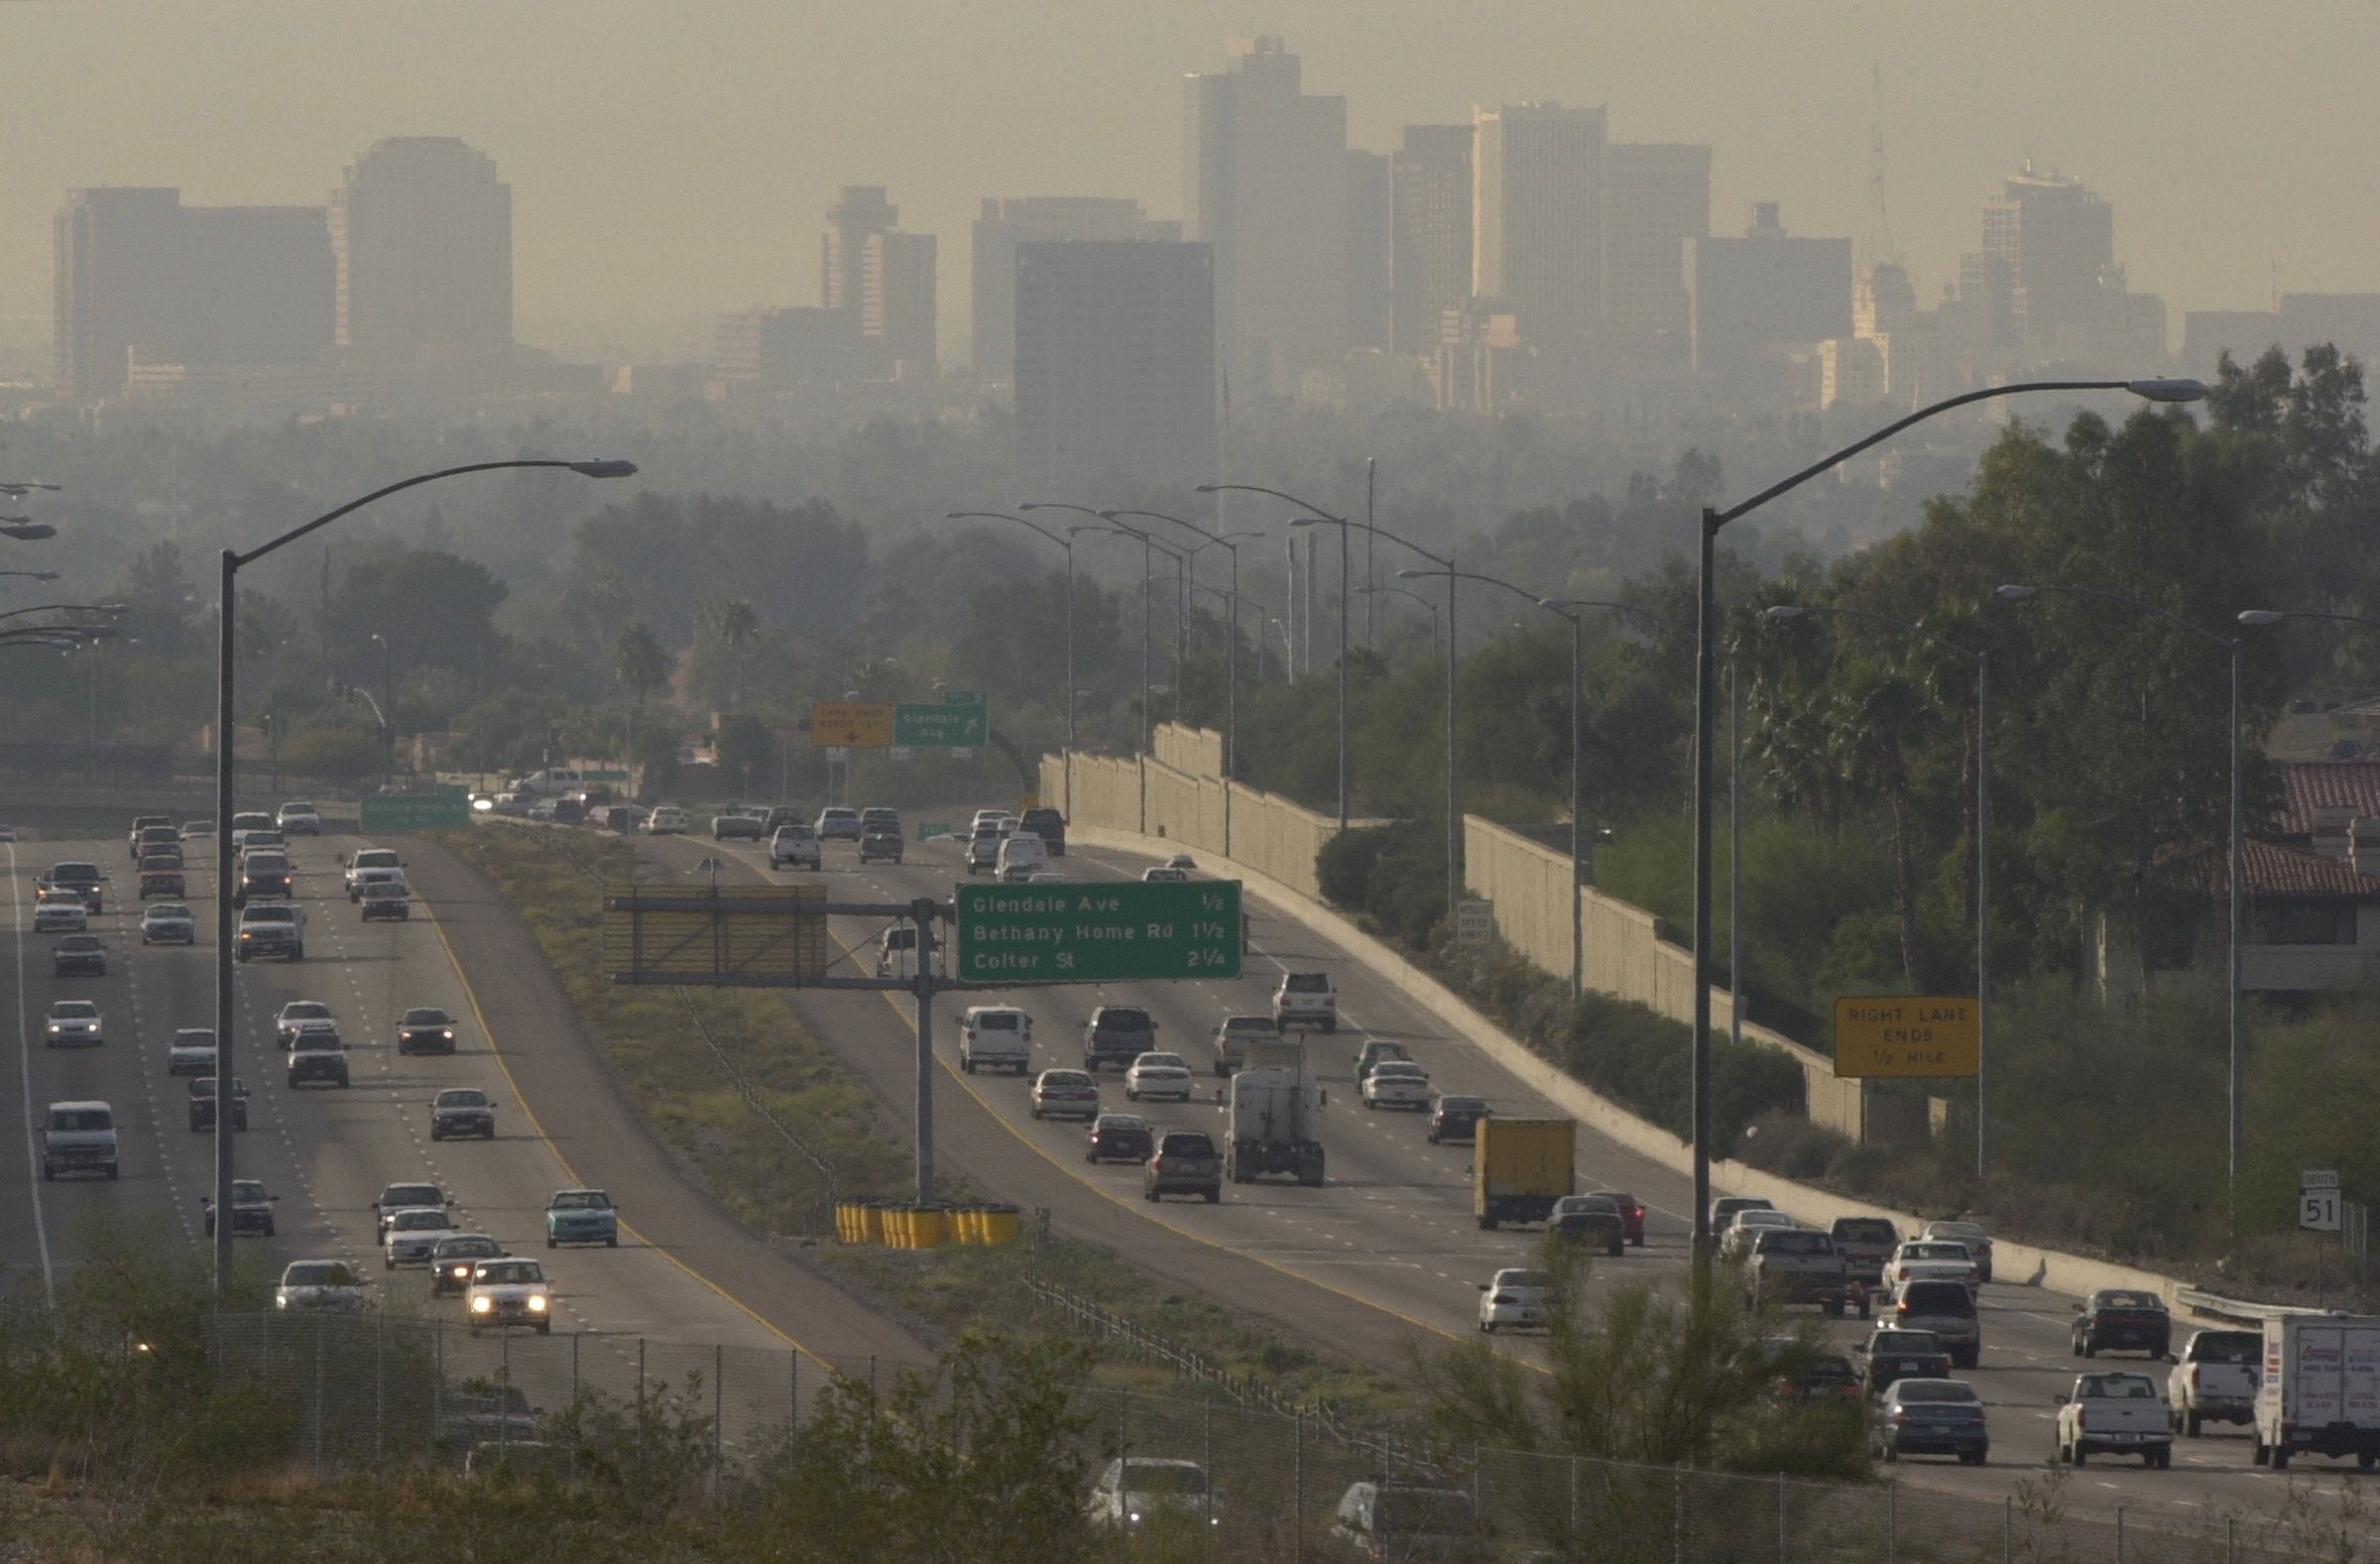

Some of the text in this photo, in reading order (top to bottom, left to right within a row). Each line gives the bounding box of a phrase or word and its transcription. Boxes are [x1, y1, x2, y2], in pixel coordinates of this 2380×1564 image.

[974, 897, 1066, 912] Glendale
[1079, 896, 1120, 911] Ave
[974, 924, 1064, 946] Bethany
[1076, 924, 1135, 940] Home
[1147, 923, 1174, 939] Rd
[974, 953, 1039, 969] Colter
[1056, 952, 1074, 969] St
[1848, 1007, 1968, 1023] RIGHT LANE
[1884, 1028, 1934, 1042] ENDS
[1908, 1050, 1945, 1064] MILE
[2305, 1173, 2337, 1186] SOUTH
[2306, 1200, 2332, 1222] 51
